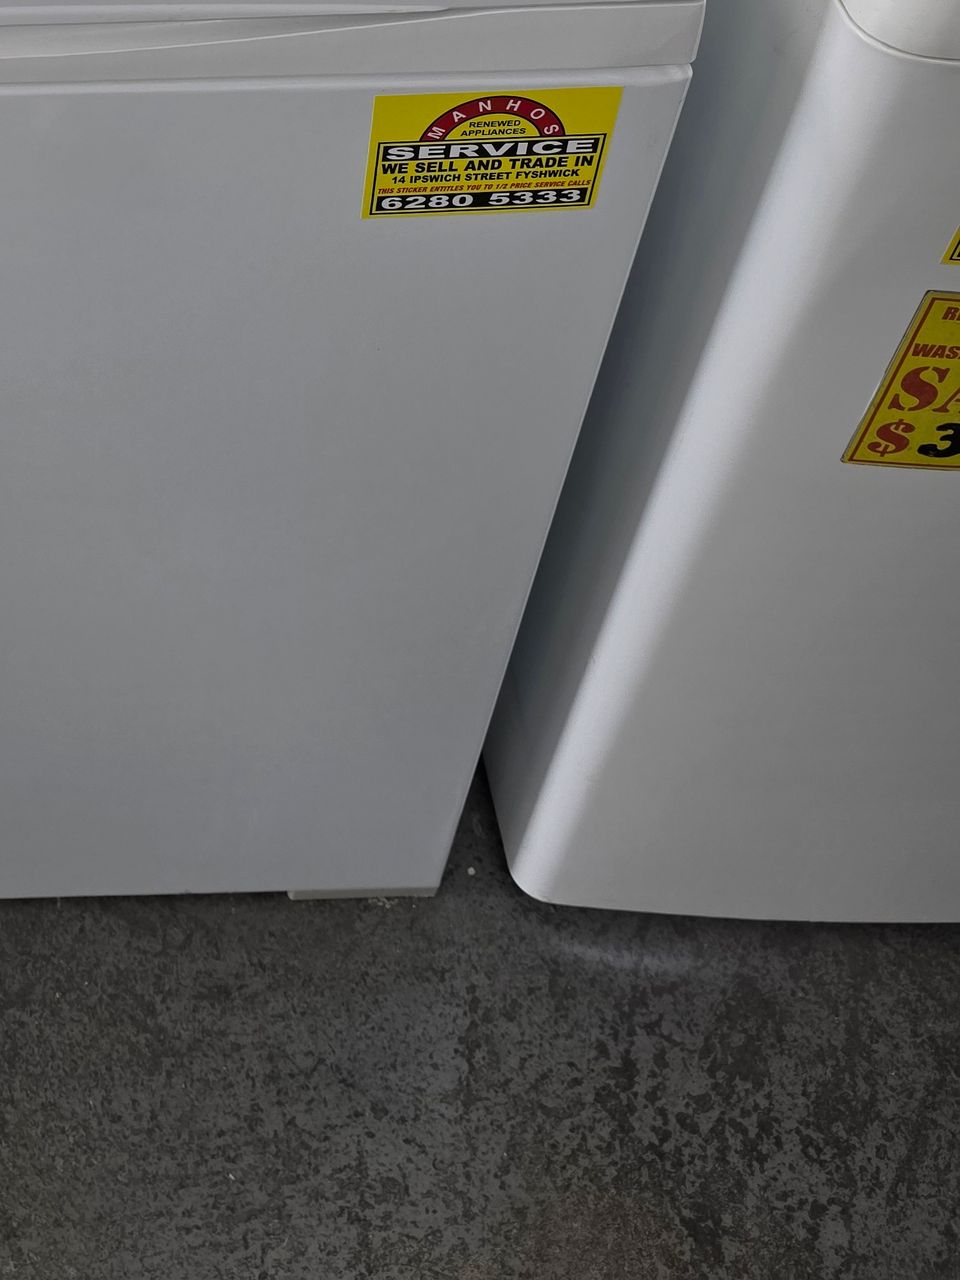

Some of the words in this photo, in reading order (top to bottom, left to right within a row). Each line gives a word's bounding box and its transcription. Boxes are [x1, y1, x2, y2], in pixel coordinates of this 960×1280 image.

[427, 99, 560, 140] MANHOS
[468, 119, 521, 128] RENEWED
[460, 127, 526, 137] APPLIANCES
[386, 139, 595, 160] SERVICE
[381, 162, 409, 175] WE
[414, 160, 458, 173] SELL
[463, 158, 502, 172] AND
[509, 156, 569, 170] TRADE
[574, 154, 595, 167] IN
[392, 176, 406, 184] 14
[409, 174, 461, 183] IPSWICH
[464, 171, 512, 181] STREET
[515, 168, 580, 179] FYSHWICK
[381, 194, 474, 210] 6280
[488, 189, 581, 205] 5333
